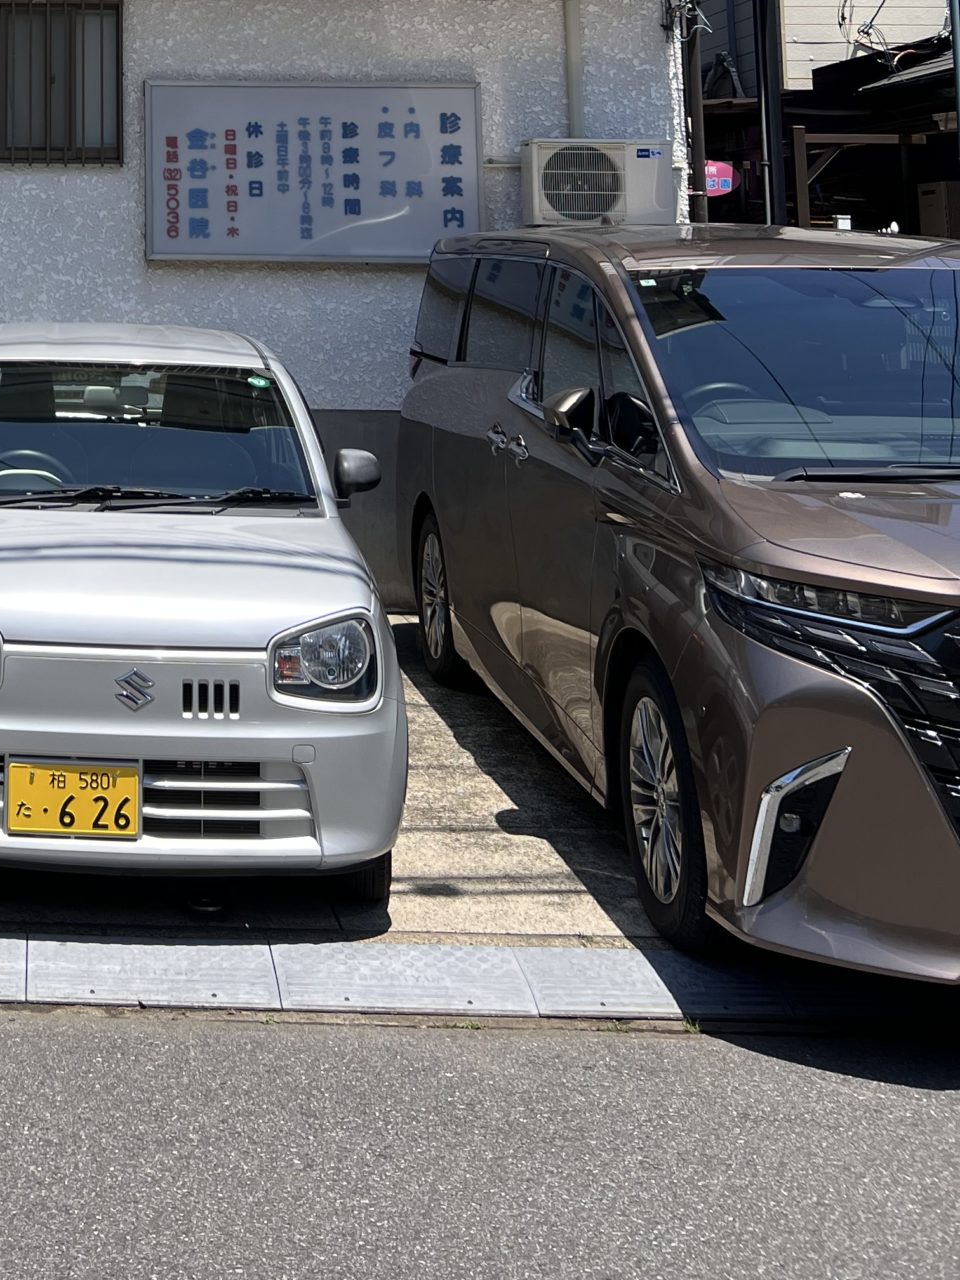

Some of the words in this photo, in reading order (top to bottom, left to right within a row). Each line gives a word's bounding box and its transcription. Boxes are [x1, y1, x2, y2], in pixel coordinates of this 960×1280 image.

[185, 127, 212, 239] 金谷医院
[245, 121, 264, 197] 休診日
[341, 121, 361, 216] 診療時間
[439, 111, 465, 229] 診療案内
[16, 801, 33, 819] た
[49, 771, 66, 789] 柏
[79, 772, 110, 791] 580
